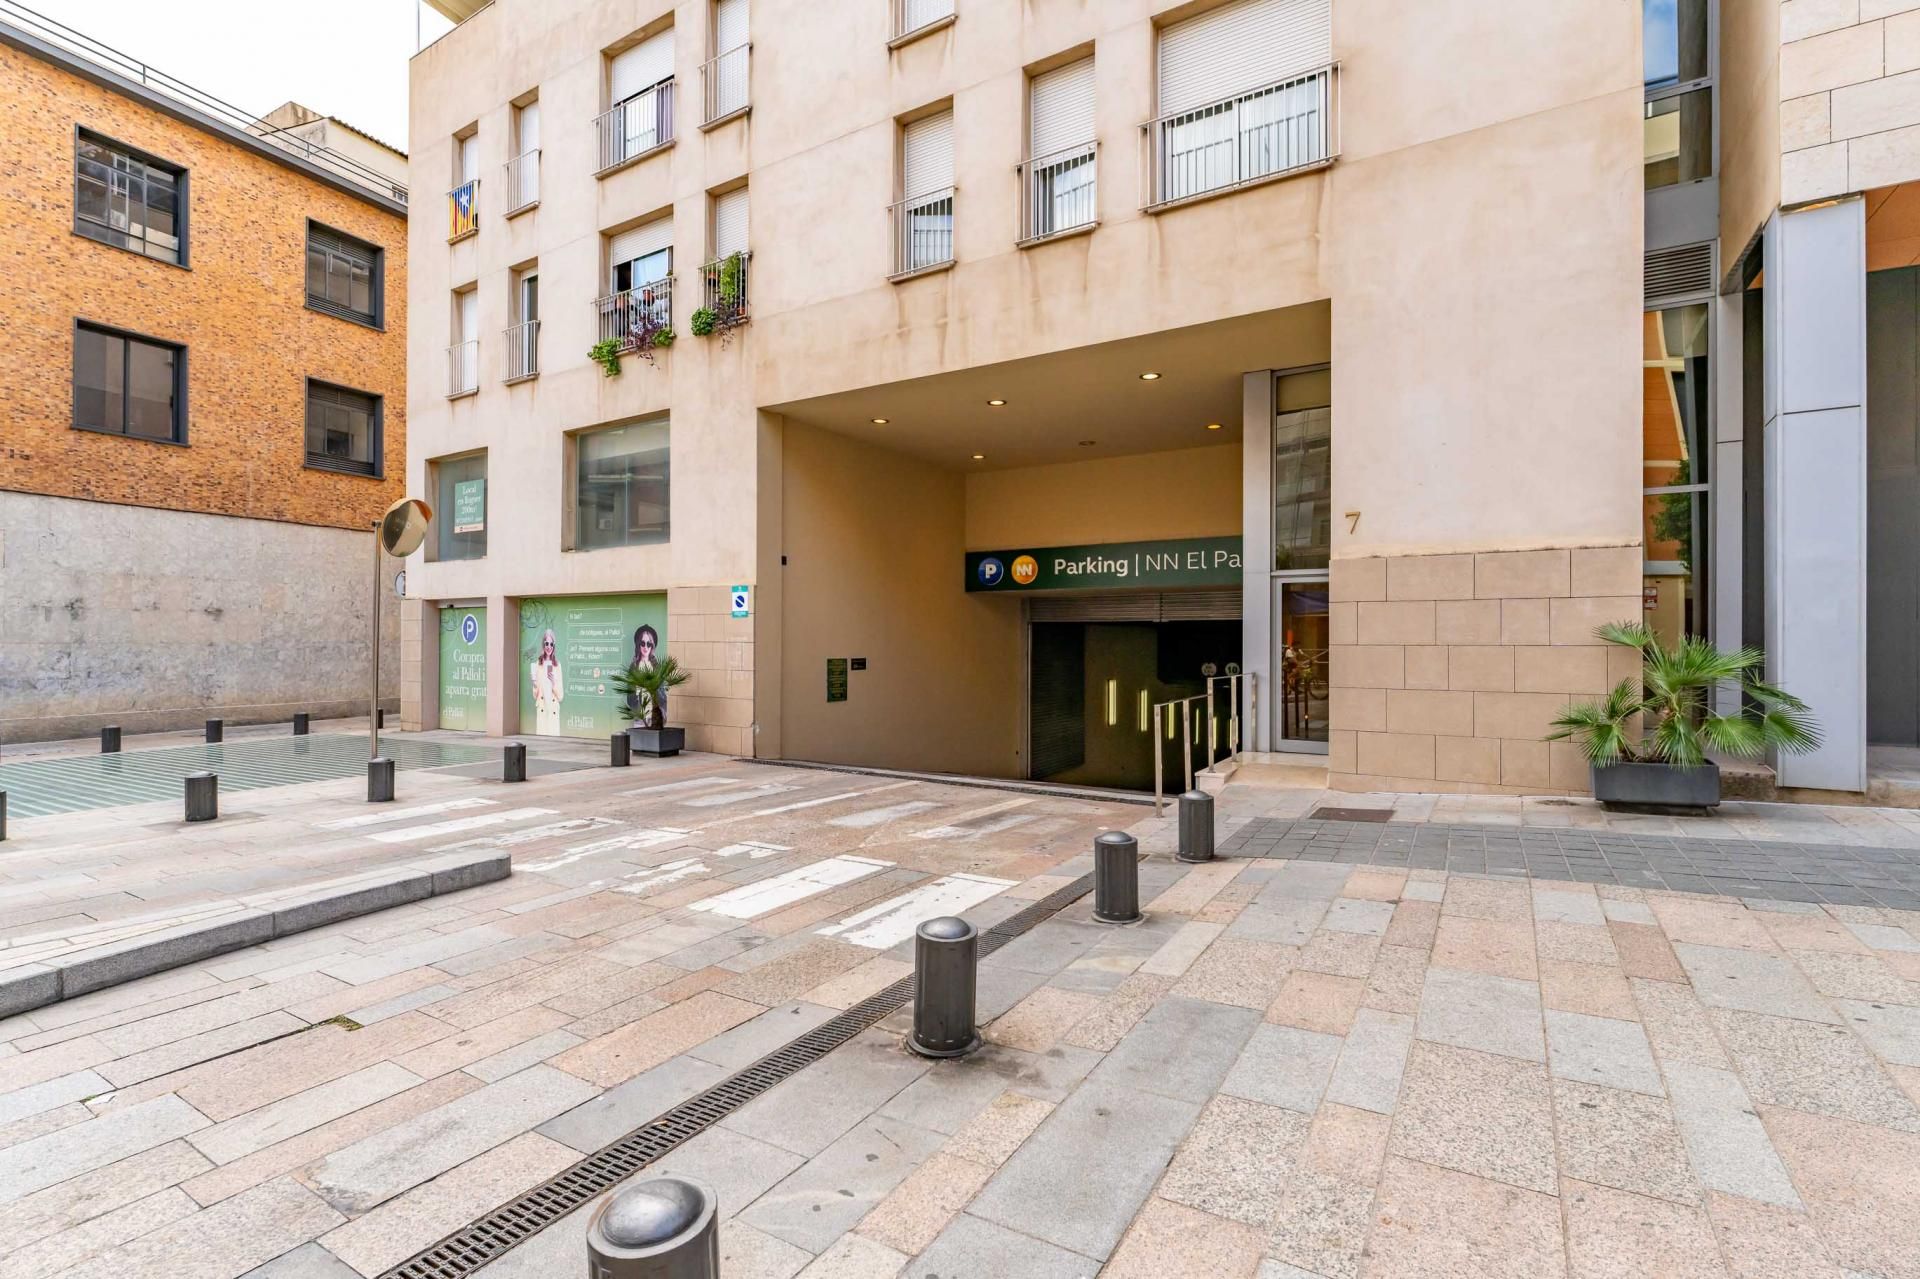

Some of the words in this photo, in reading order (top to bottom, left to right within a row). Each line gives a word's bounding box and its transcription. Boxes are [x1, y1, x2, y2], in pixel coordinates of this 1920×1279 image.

[1344, 511, 1361, 535] 7
[1054, 556, 1128, 577] Parking
[1145, 553, 1179, 571] NN
[1187, 550, 1207, 569] El
[453, 648, 485, 667] Compra
[452, 666, 460, 680] al
[461, 666, 481, 681] Pallol
[445, 685, 470, 699] aparca
